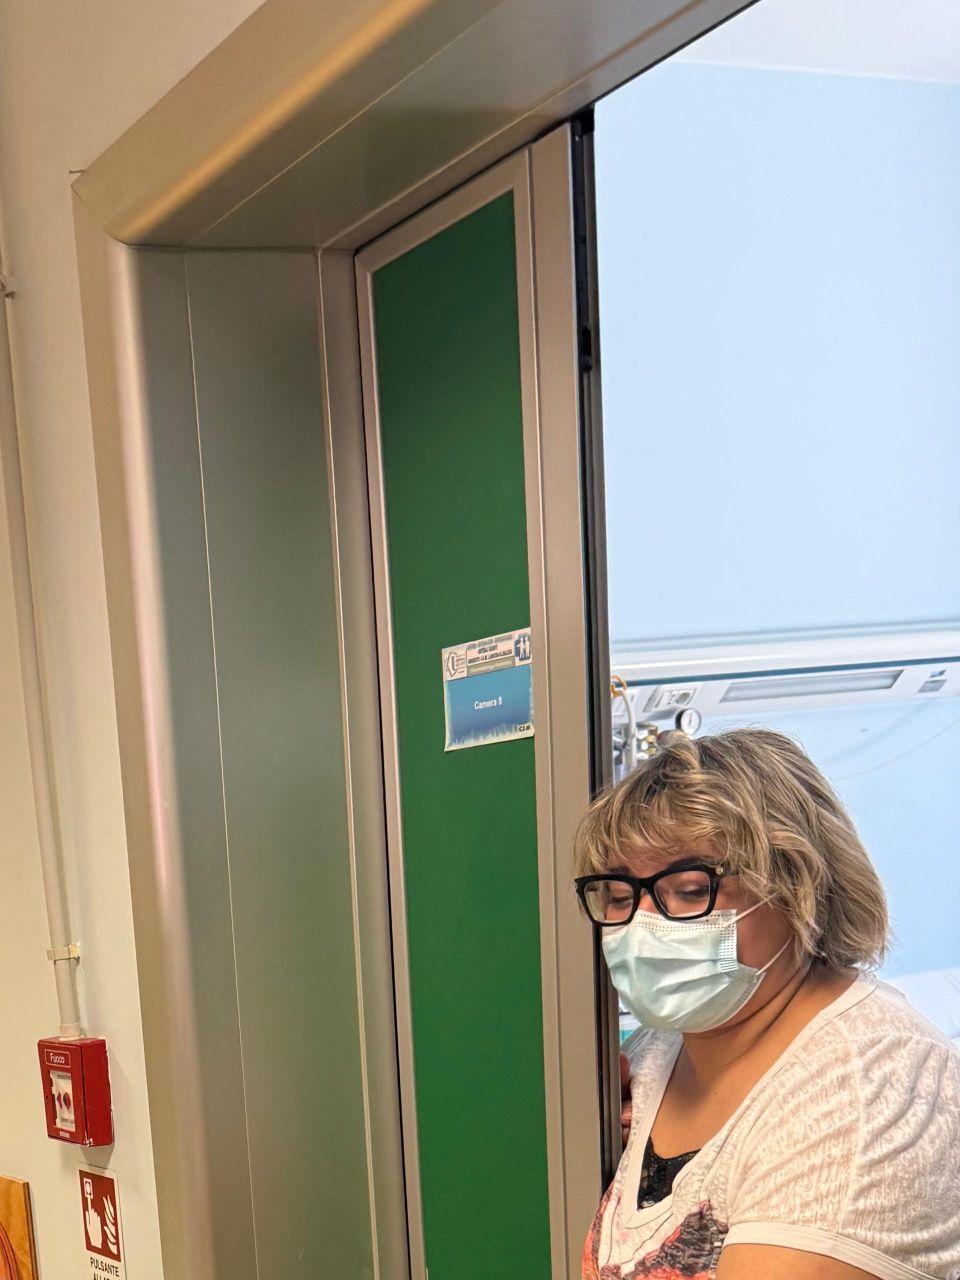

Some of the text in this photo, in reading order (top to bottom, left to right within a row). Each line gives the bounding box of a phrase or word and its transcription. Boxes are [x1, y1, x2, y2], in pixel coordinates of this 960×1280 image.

[474, 699, 497, 710] Camera
[50, 1053, 65, 1064] Fuoco
[90, 1257, 120, 1277] PULSANTE
